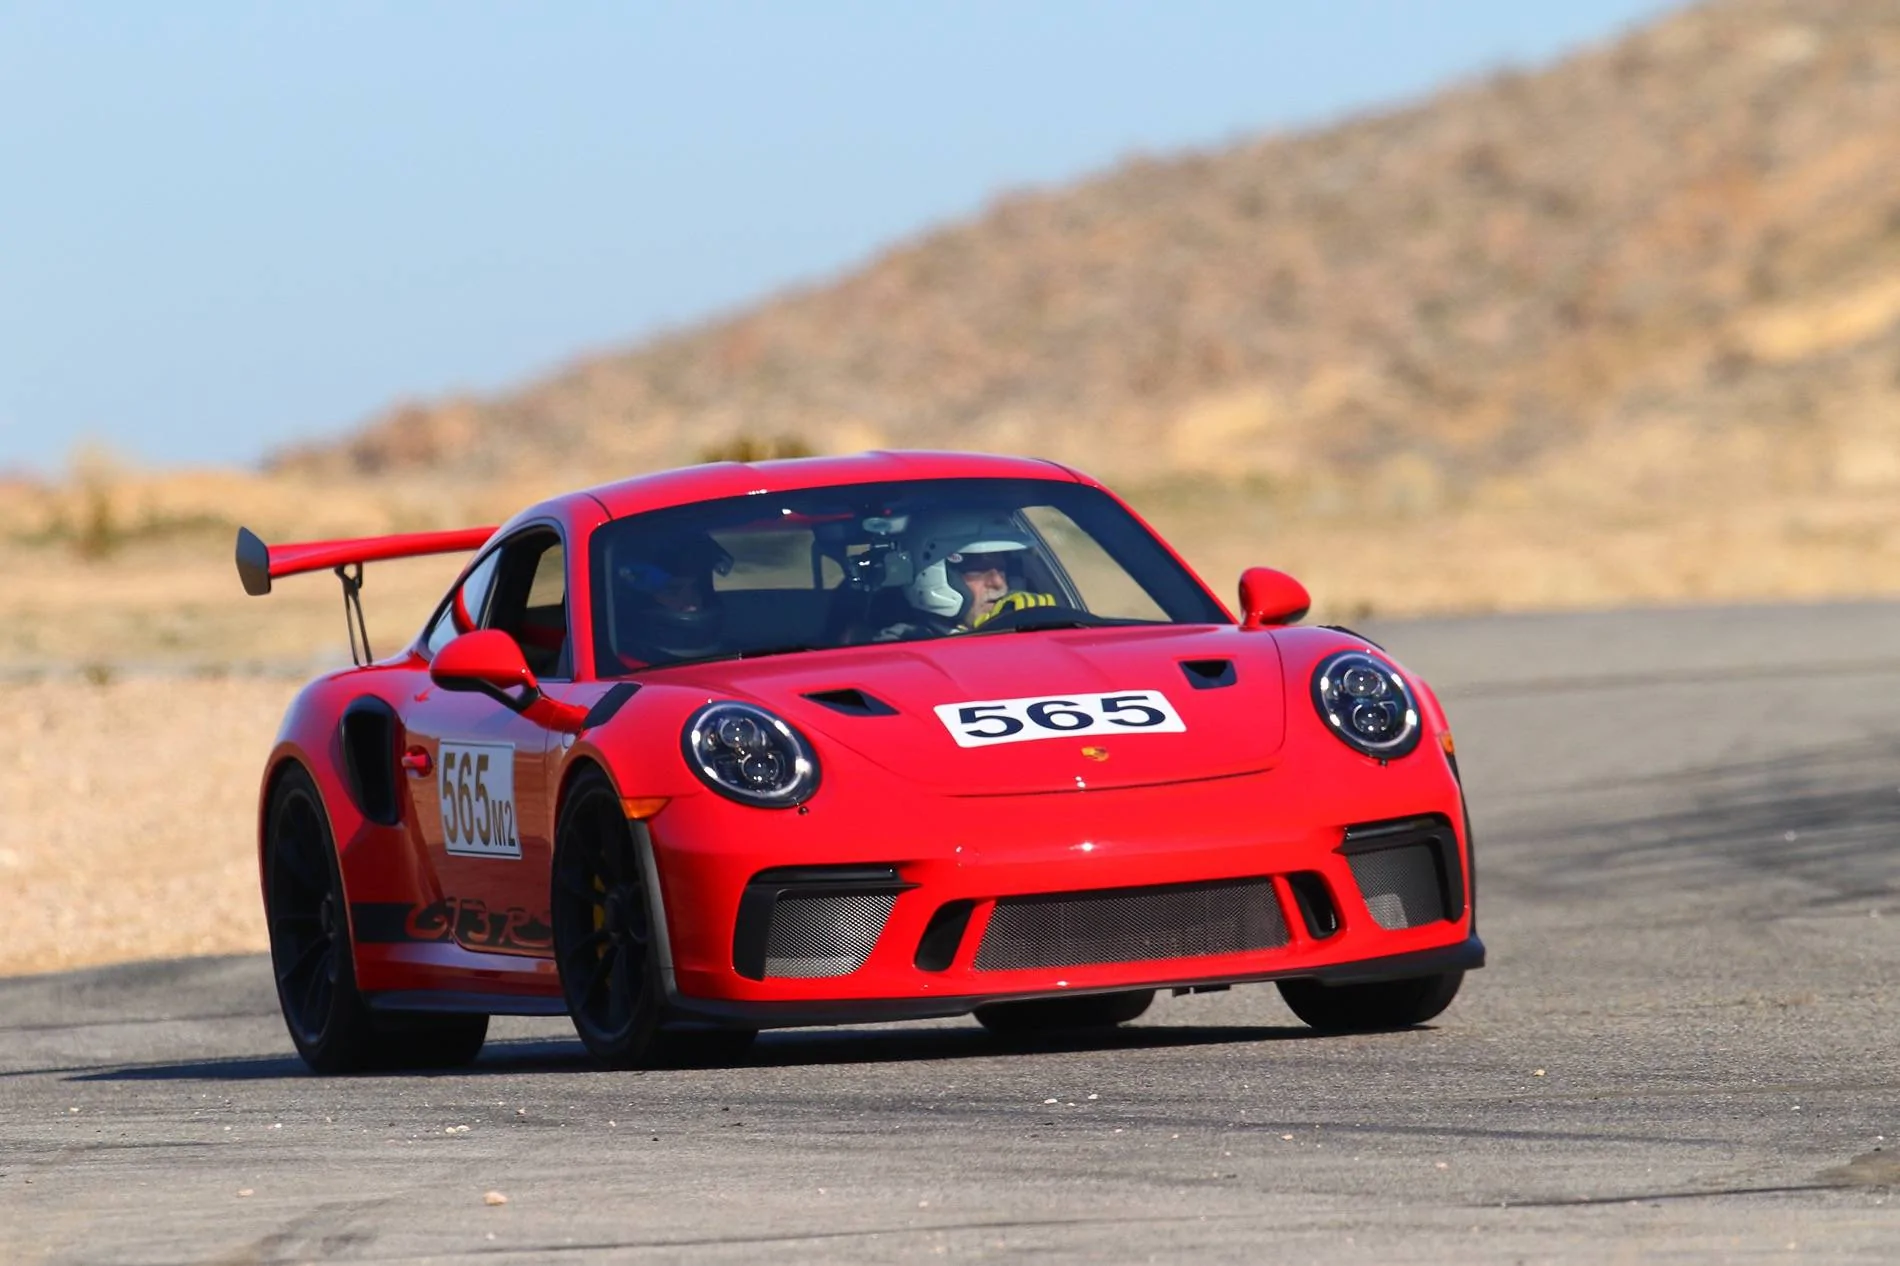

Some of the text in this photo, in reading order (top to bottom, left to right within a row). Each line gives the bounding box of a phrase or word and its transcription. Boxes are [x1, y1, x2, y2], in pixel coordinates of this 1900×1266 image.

[958, 695, 1166, 738] 565
[442, 752, 517, 847] 565 M2
